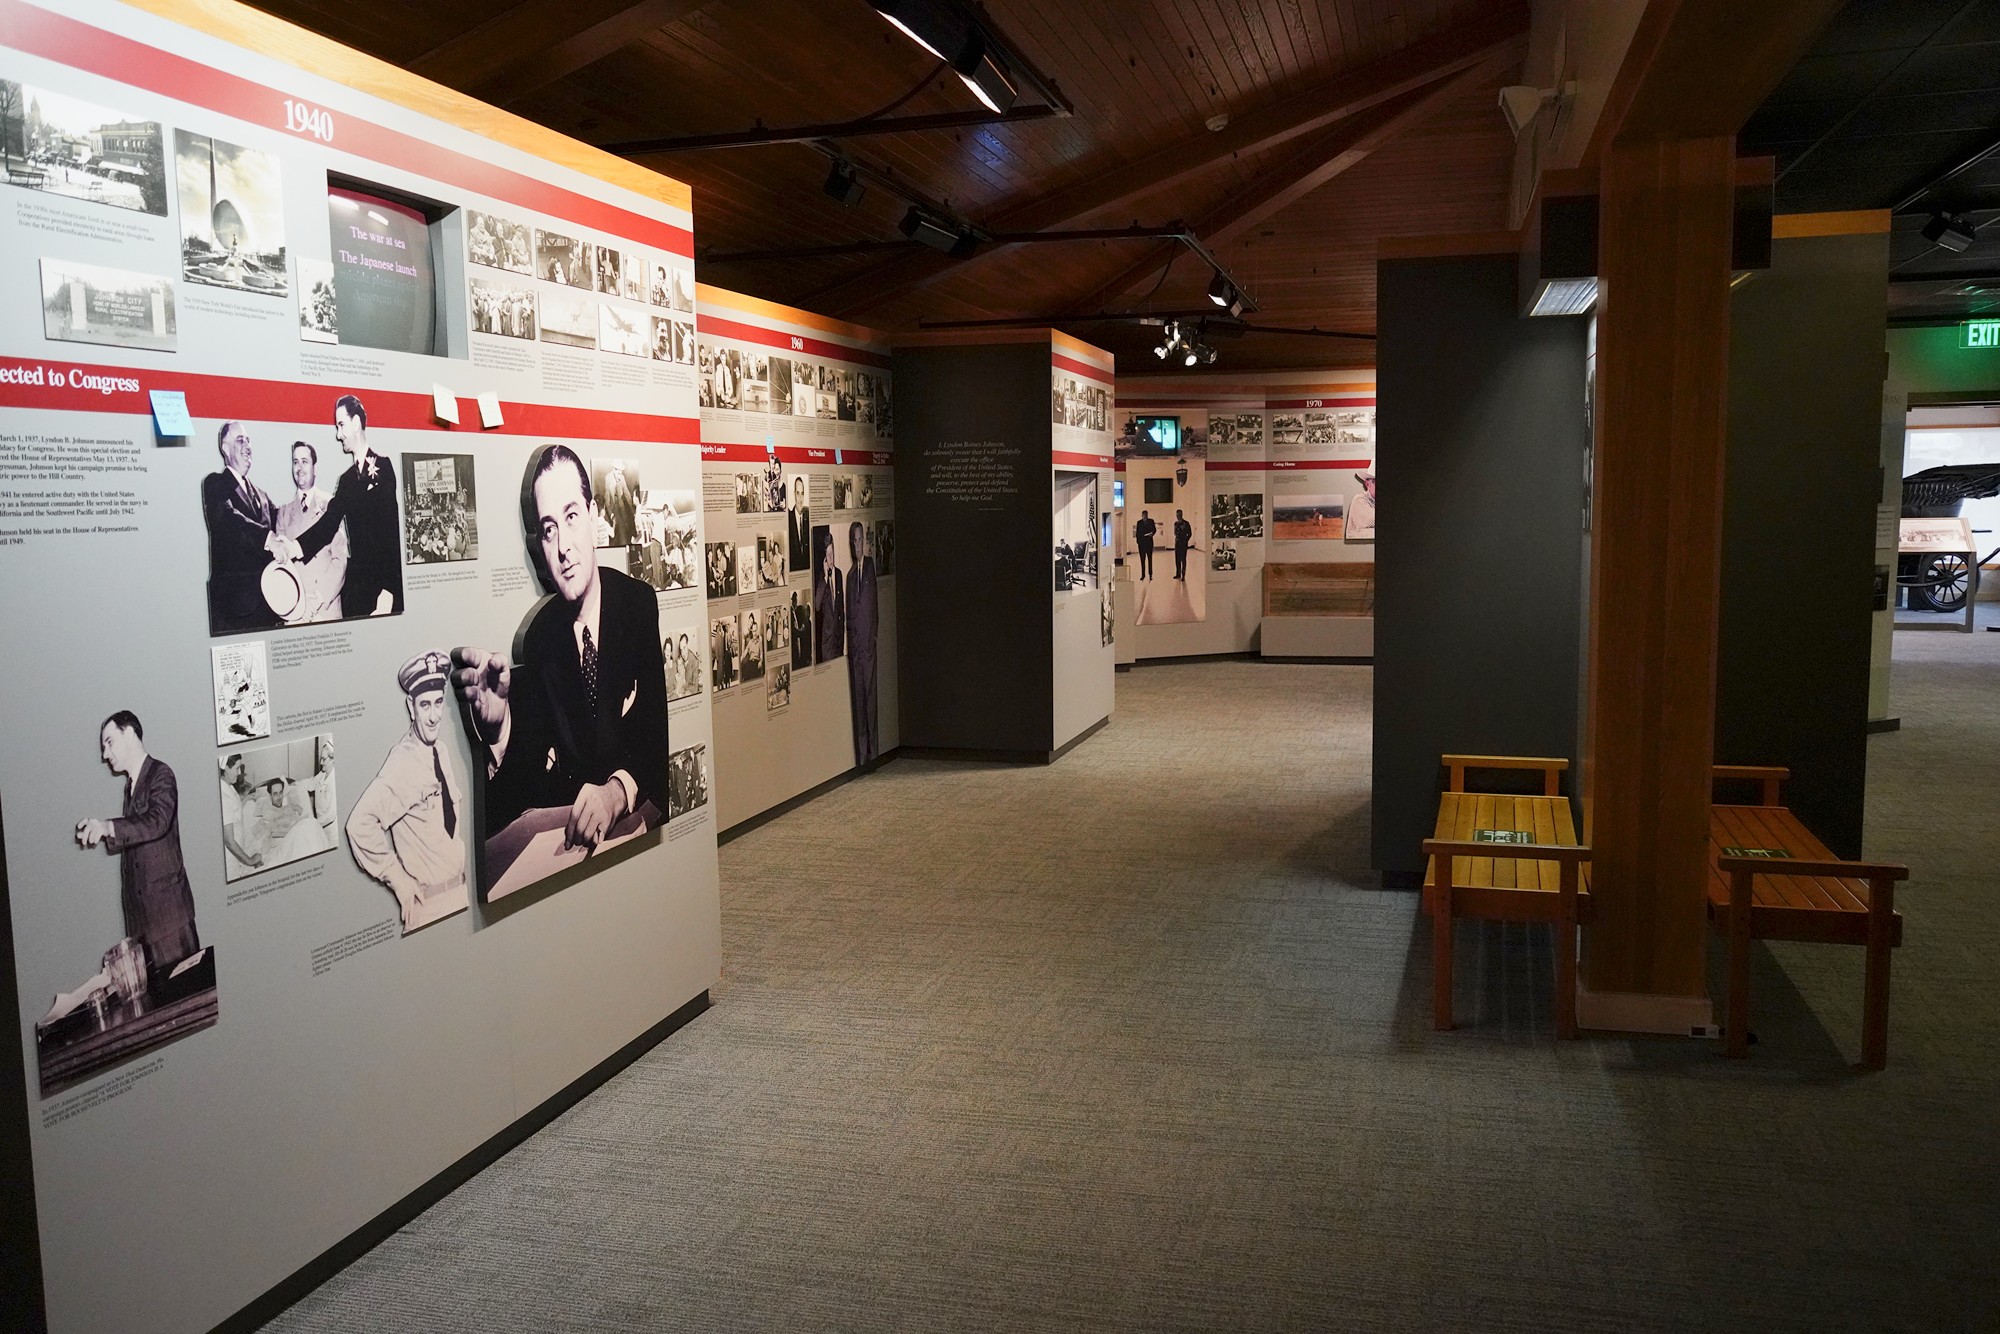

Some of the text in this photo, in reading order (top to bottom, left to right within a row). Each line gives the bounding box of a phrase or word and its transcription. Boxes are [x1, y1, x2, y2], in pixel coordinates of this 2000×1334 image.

[282, 99, 334, 143] 1940
[349, 226, 406, 250] The war at sea
[339, 249, 417, 277] The Japanese launch
[127, 296, 142, 305] CITY
[1968, 324, 2000, 346] EXIT
[48, 368, 65, 387] to
[68, 369, 140, 395] Congress
[28, 446, 56, 454] Congress.
[63, 491, 76, 499] duty
[98, 526, 138, 534] Representatives
[9, 537, 25, 545] 1949.
